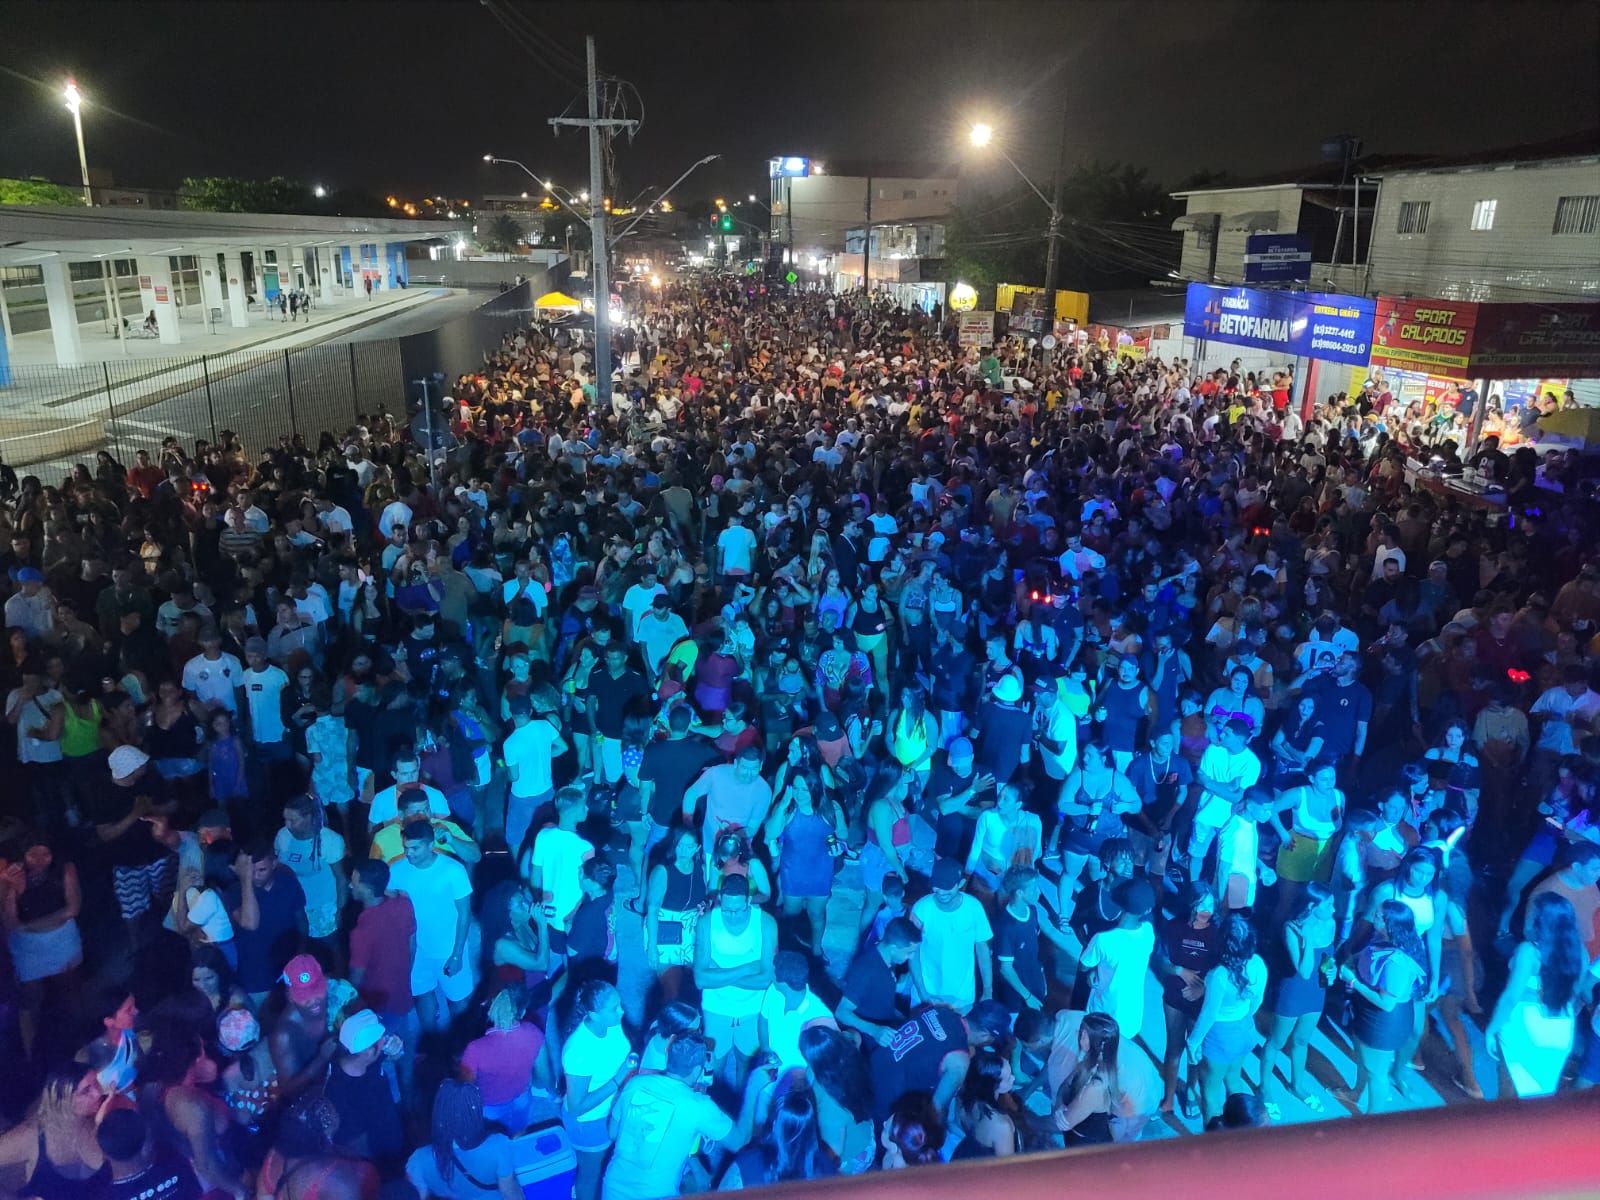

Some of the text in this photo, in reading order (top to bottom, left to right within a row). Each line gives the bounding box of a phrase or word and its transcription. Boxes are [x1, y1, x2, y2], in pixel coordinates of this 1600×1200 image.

[1221, 295, 1249, 310] FARMÁCIA
[1415, 308, 1456, 325] SPORT
[1219, 313, 1288, 342] BETOFARMA
[1400, 324, 1466, 345] CALÇADOS
[890, 1020, 924, 1062] 81
